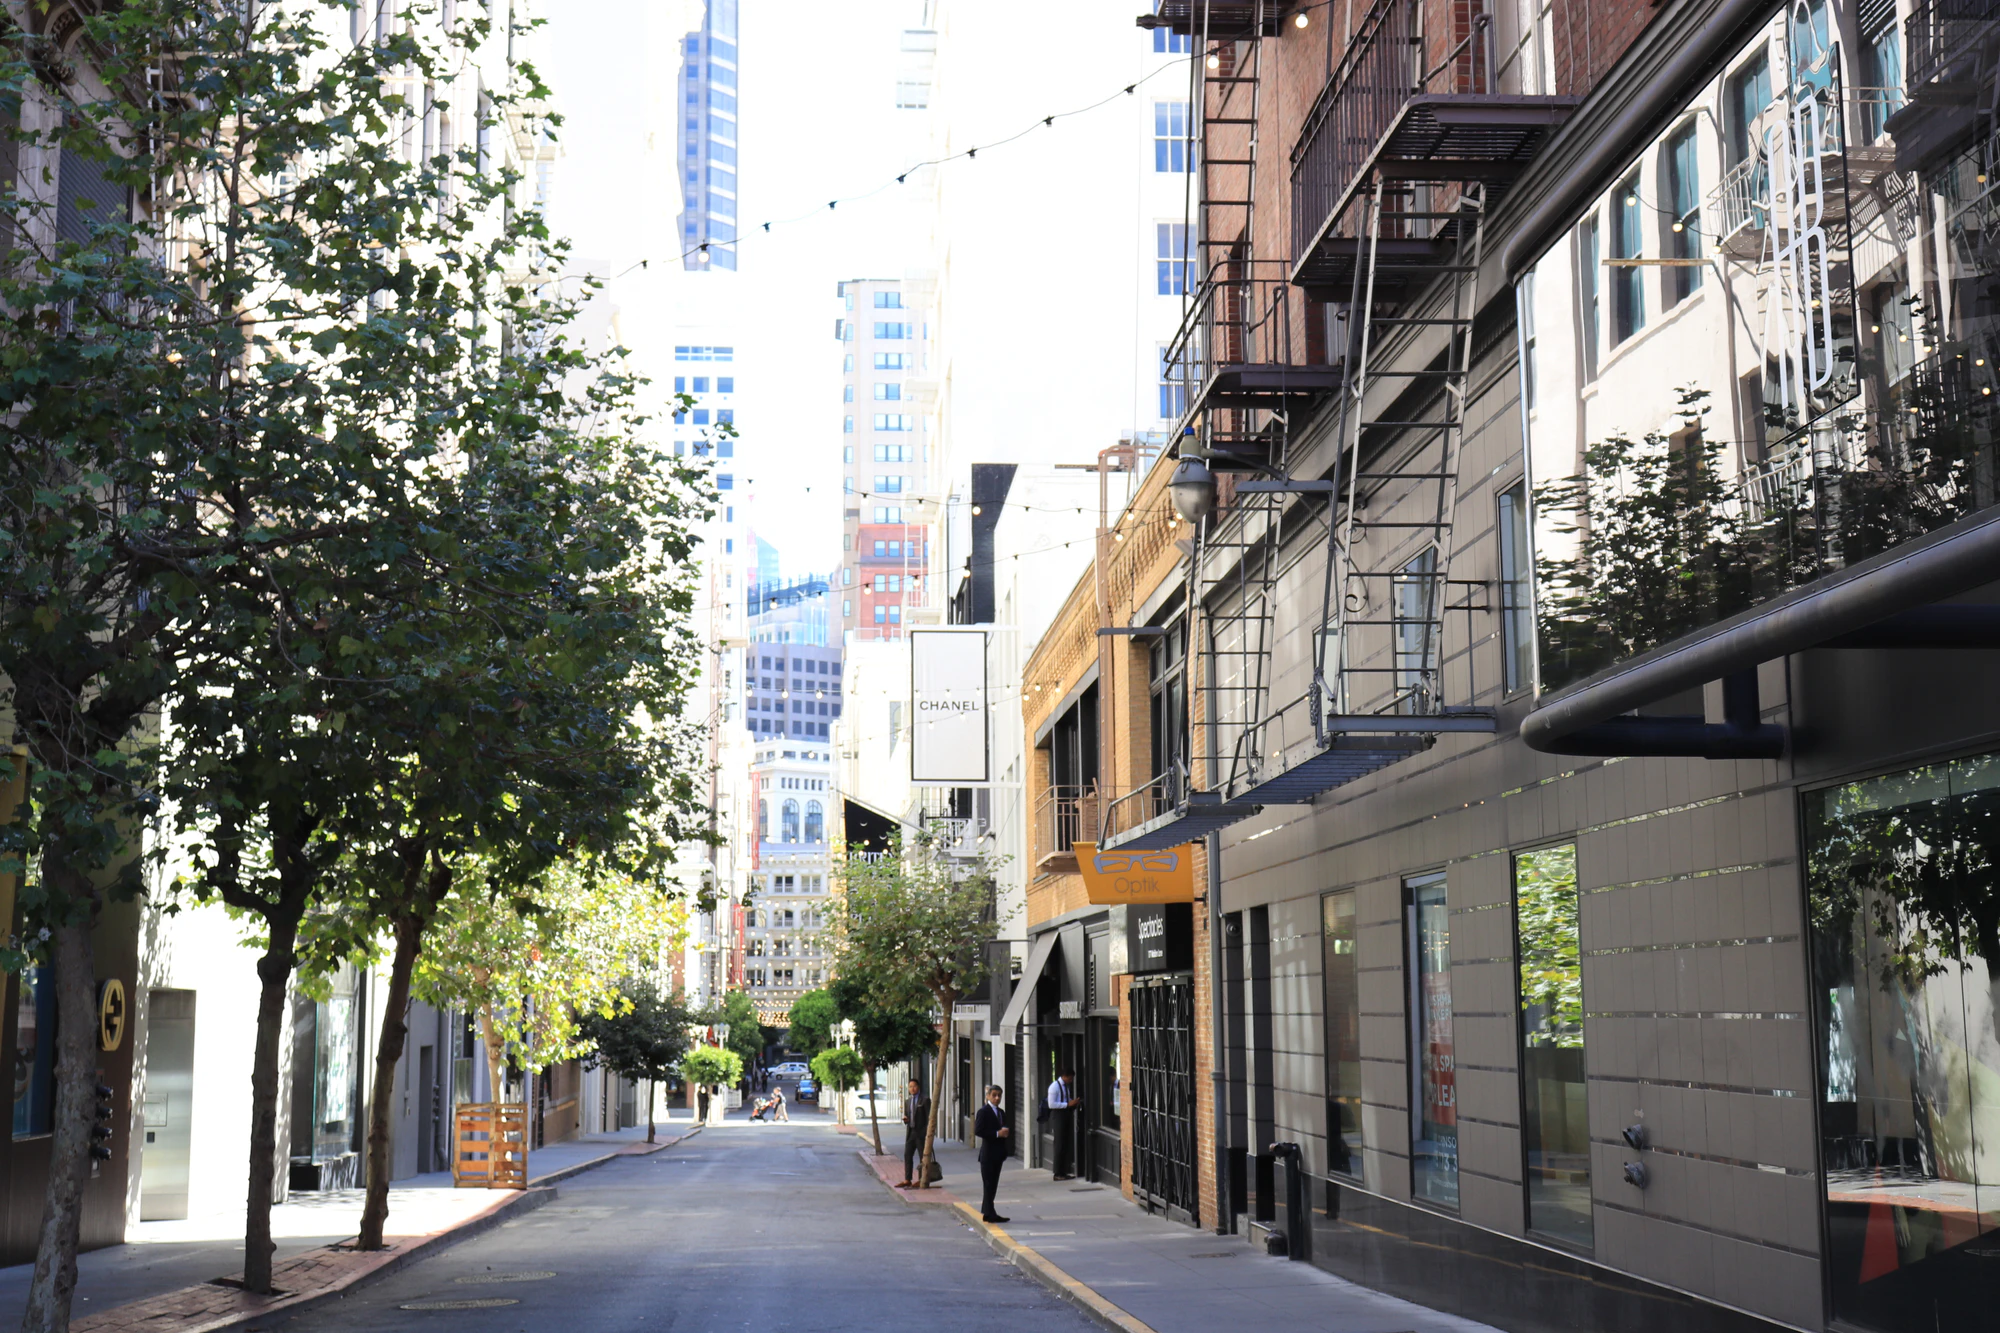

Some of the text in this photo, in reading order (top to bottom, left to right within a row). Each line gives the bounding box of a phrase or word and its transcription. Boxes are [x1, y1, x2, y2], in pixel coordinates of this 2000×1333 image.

[919, 701, 980, 711] CHANEL
[1114, 877, 1160, 896] Optik
[1138, 914, 1164, 944] Spectacles
